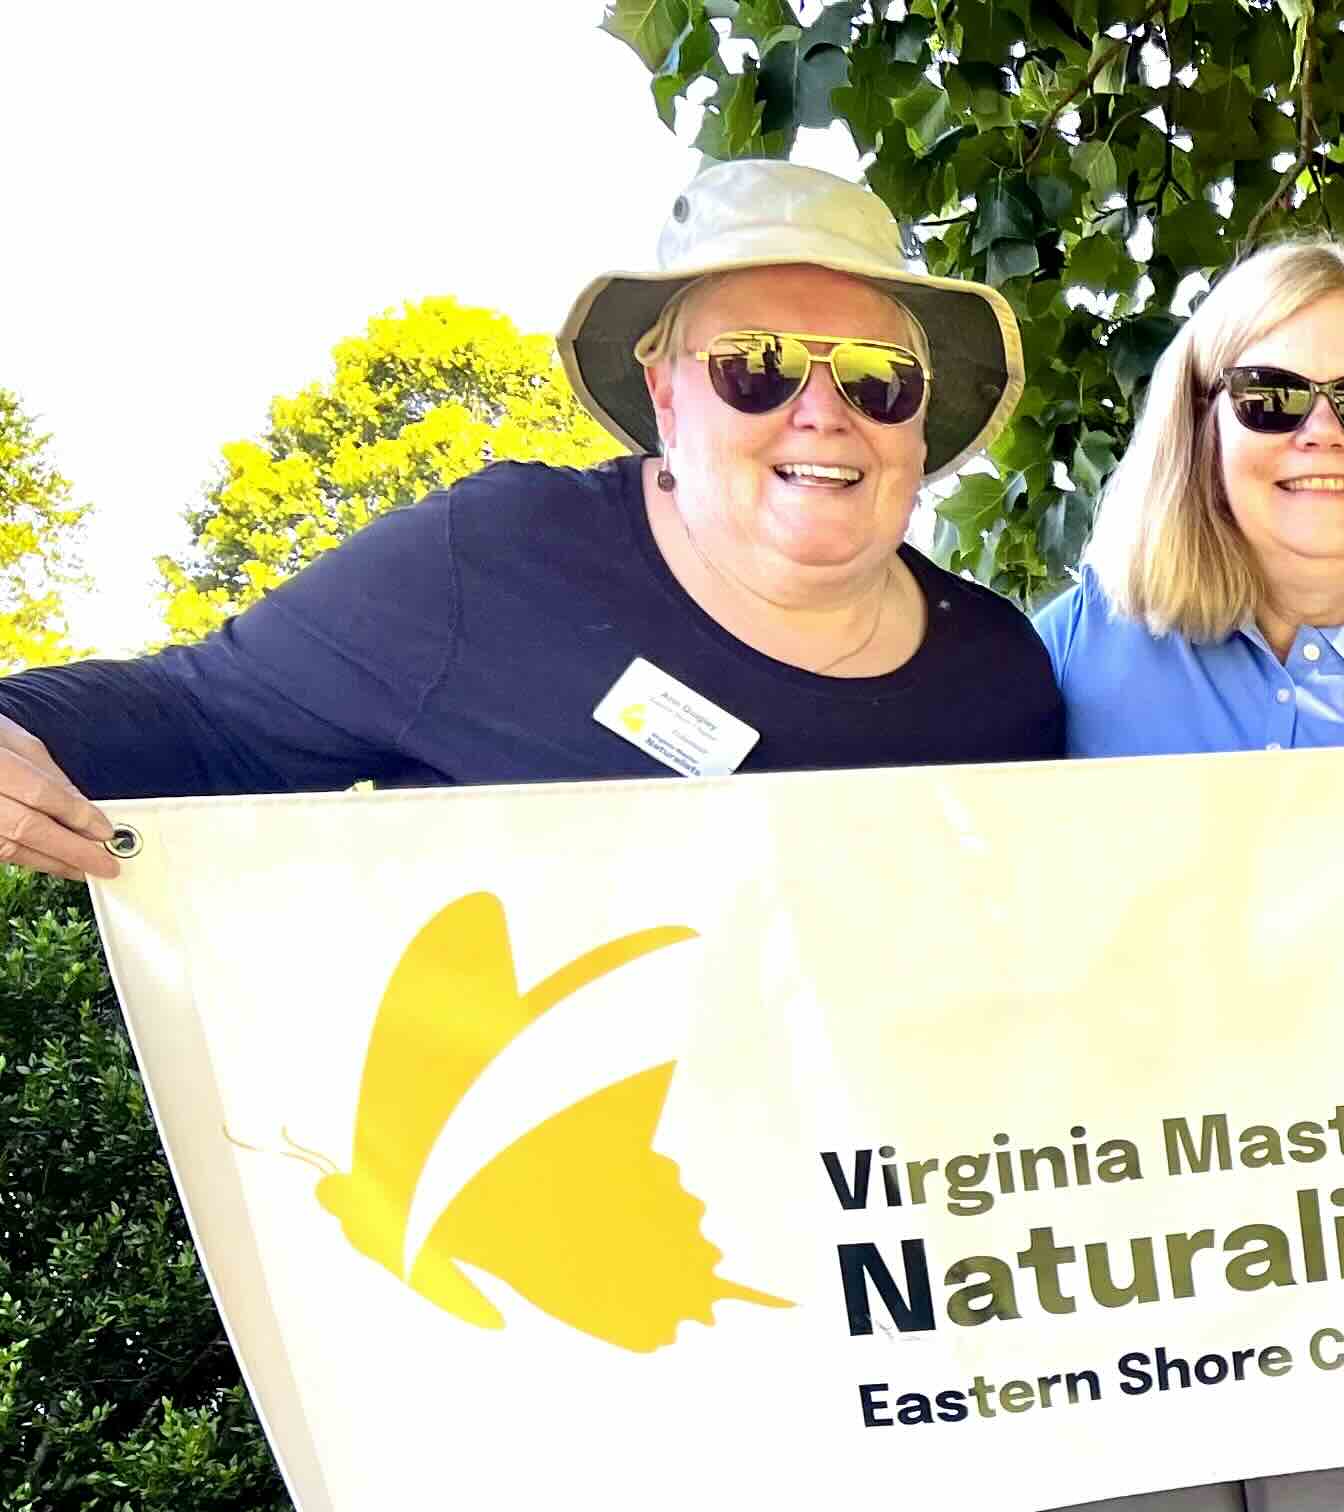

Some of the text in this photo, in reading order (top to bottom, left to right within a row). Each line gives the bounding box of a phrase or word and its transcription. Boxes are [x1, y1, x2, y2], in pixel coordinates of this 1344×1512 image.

[820, 1126, 1143, 1217] Virginia
[858, 1369, 1102, 1428] Eastern
[1118, 1345, 1294, 1396] Shore
